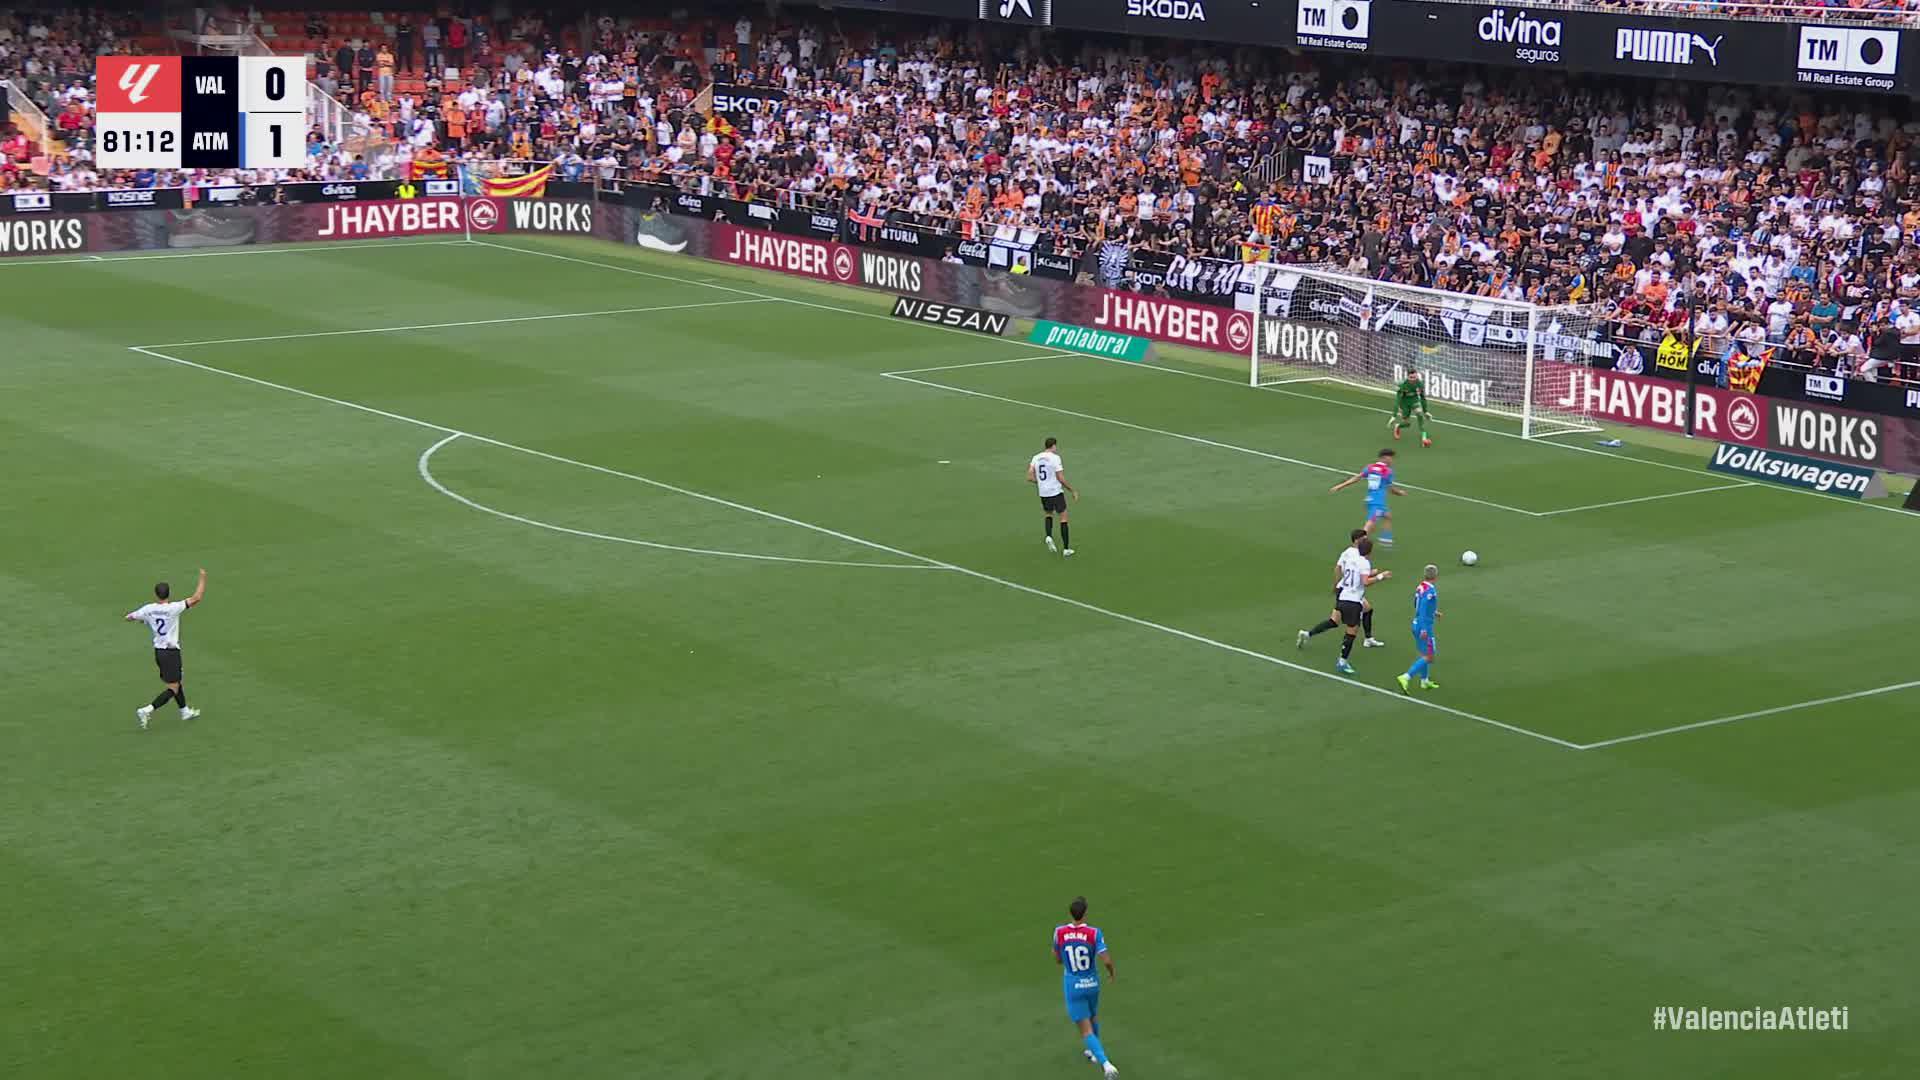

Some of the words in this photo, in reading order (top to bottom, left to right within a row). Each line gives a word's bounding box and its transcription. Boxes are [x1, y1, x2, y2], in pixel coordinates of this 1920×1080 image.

[1303, 8, 1326, 26] TM
[1478, 9, 1562, 46] divina
[1297, 36, 1308, 45] TM
[1309, 37, 1323, 47] Real
[1324, 38, 1345, 48] Estate
[1346, 40, 1368, 52] Group
[1516, 48, 1560, 64] seguros
[1616, 28, 1692, 64] PUMA
[1807, 38, 1838, 61] TM
[1797, 72, 1812, 82] TM
[1813, 73, 1833, 84] Real
[1834, 75, 1863, 86] Estate
[1864, 77, 1895, 90] Group
[1307, 163, 1326, 178] TM
[513, 200, 592, 232] WORKS
[889, 228, 919, 245] TURIA
[862, 252, 921, 292] WORKS
[894, 299, 1007, 334] NISSAN
[1045, 325, 1133, 356] prolaboral
[1264, 319, 1339, 366] WORKS
[1776, 405, 1877, 460] WORKS
[1038, 464, 1047, 481] 5
[1715, 444, 1871, 493] Volkswagen
[1343, 568, 1355, 587] 21
[155, 618, 168, 636] 2
[1065, 945, 1091, 972] 16
